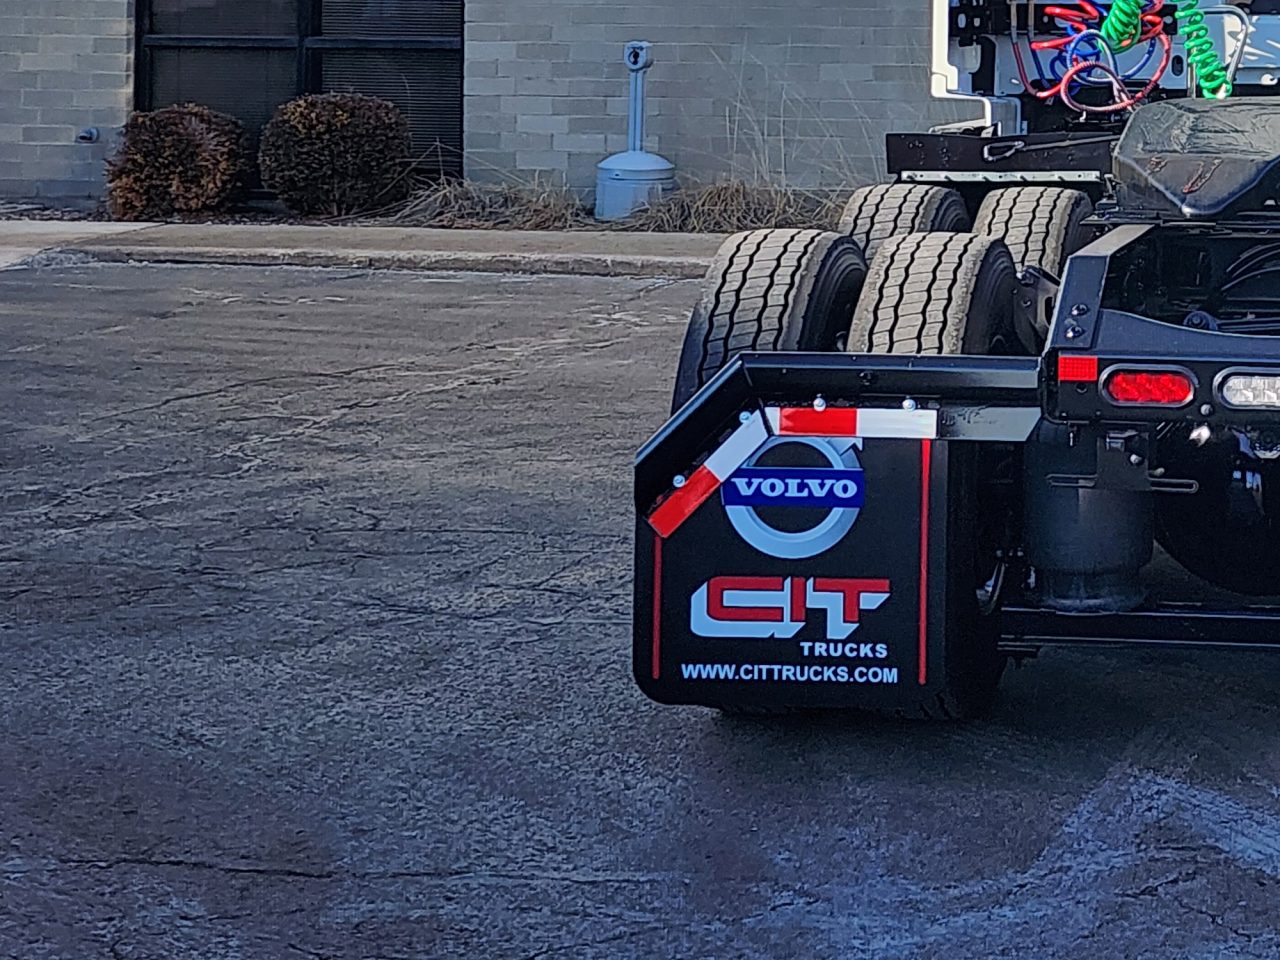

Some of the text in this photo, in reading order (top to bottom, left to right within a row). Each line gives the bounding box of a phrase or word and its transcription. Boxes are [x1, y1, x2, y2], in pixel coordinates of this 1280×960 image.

[731, 477, 857, 498] VOLVO
[690, 575, 891, 640] CIT
[800, 641, 888, 658] TRUCKS
[681, 663, 898, 684] WWW.CITTRUCKS.COM
